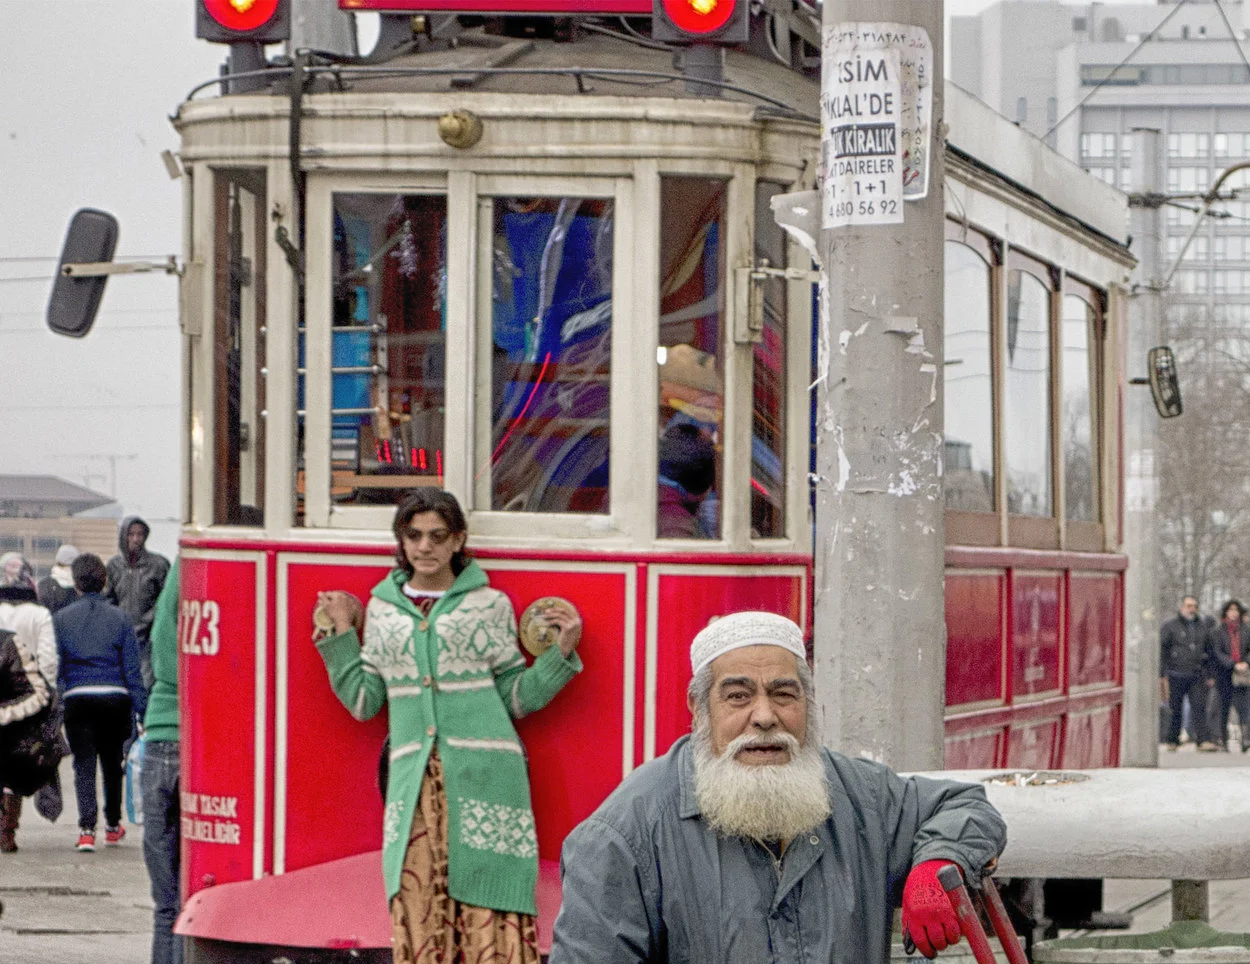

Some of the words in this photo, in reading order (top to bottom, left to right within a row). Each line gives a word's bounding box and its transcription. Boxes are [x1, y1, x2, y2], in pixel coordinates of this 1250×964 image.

[844, 124, 895, 154] KİRALIK
[839, 157, 895, 176] DAİRELER
[854, 180, 886, 196] 1+1
[859, 201, 875, 216] 56
[879, 200, 897, 215] 92
